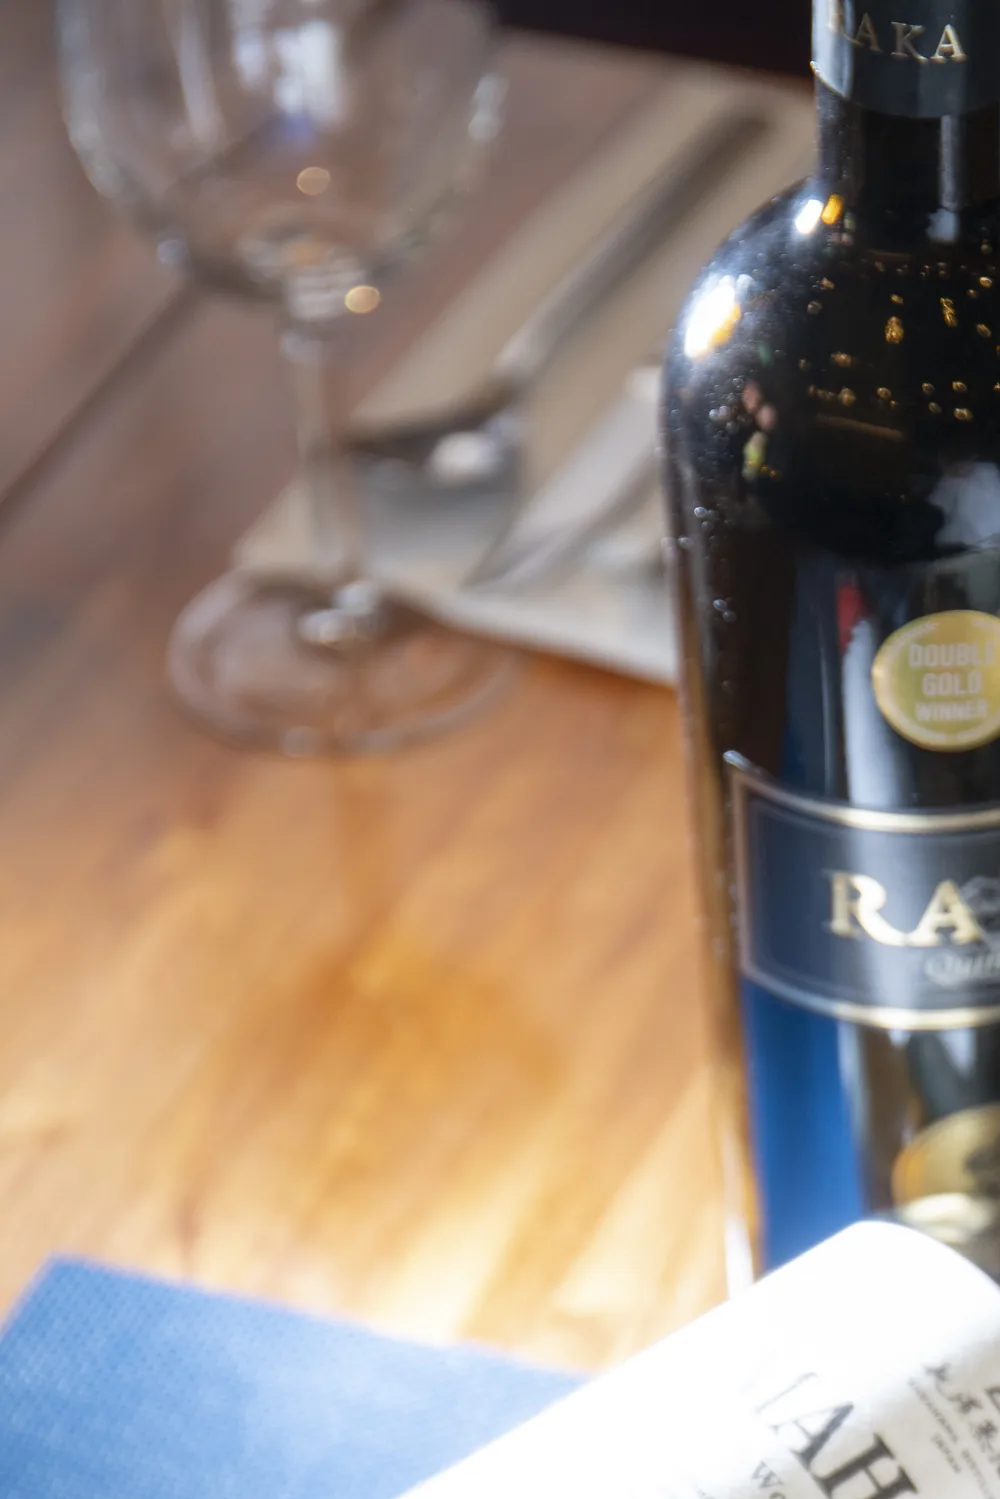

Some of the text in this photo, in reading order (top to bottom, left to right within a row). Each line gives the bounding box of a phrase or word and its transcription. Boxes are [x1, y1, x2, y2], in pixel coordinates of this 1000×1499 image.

[908, 639, 997, 668] DOUBLE
[922, 669, 983, 698] GOLD
[915, 699, 989, 722] WINNER
